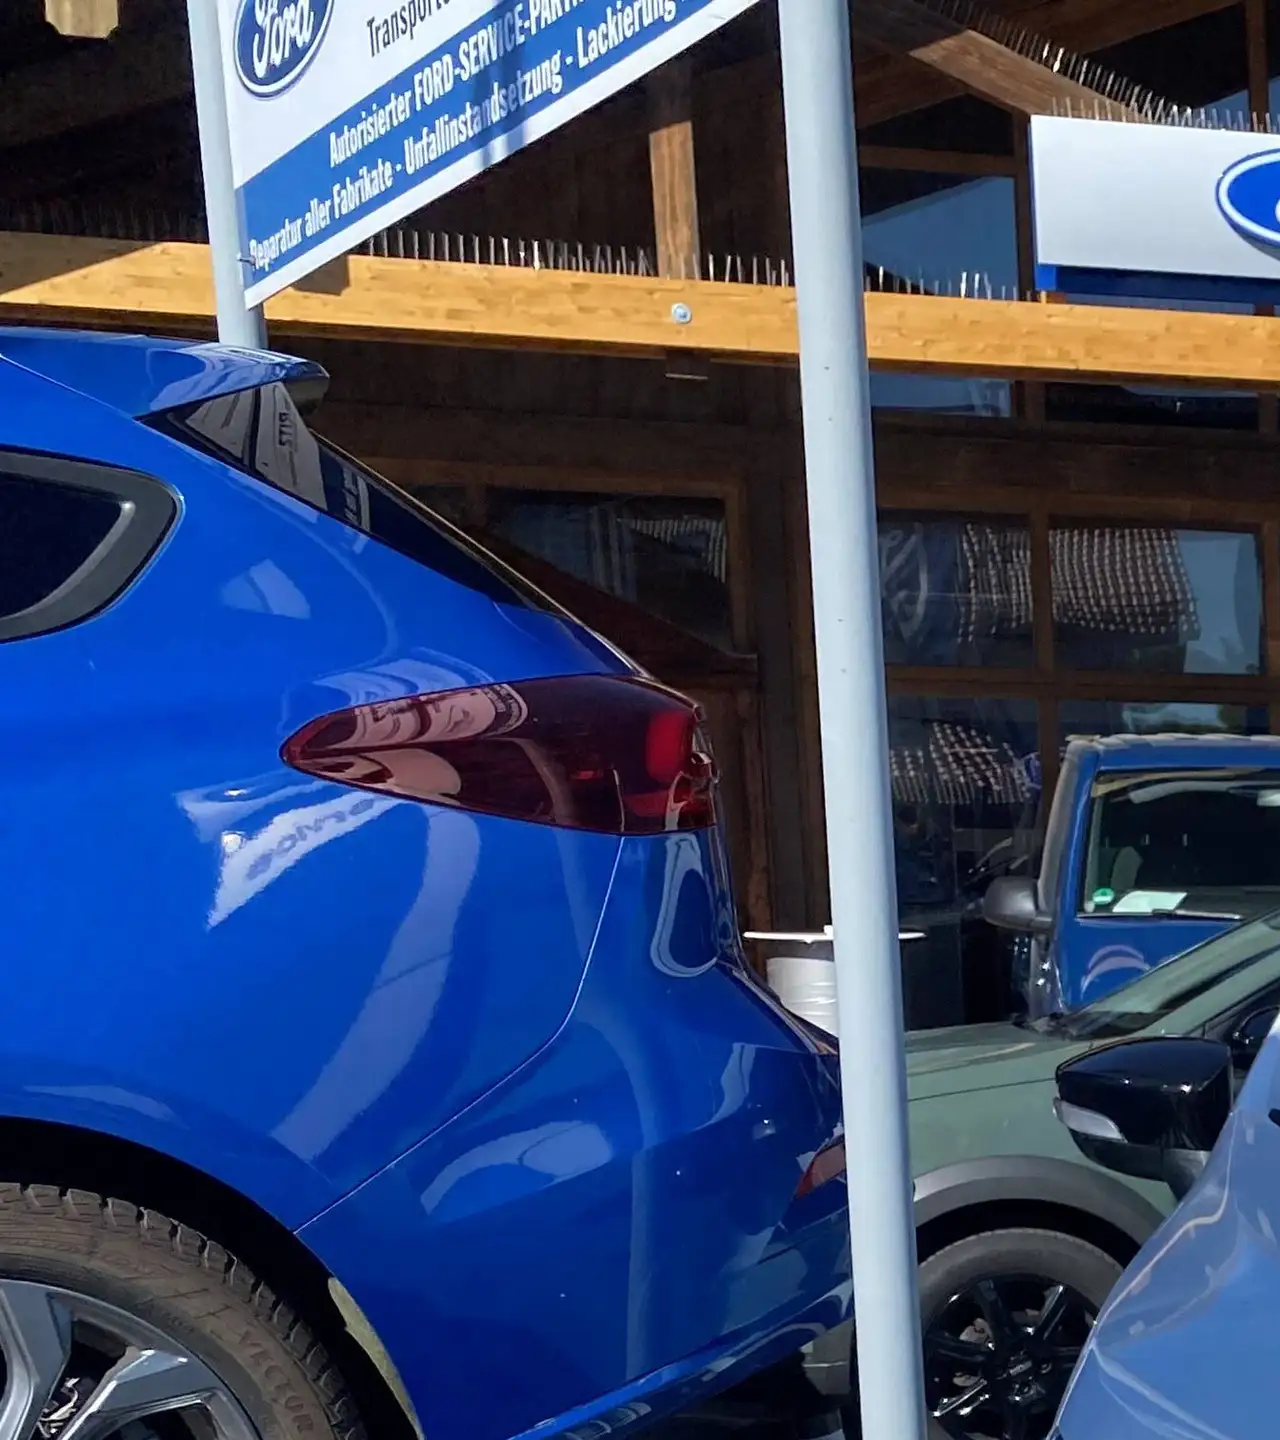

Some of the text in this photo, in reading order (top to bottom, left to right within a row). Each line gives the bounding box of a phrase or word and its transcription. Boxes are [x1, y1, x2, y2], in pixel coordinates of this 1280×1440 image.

[252, 0, 315, 79] Ford
[329, 0, 583, 169] Autorisierter FORD-SERVICE-PAR
[366, 0, 450, 58] Transpor
[249, 217, 303, 272] Reparatur
[304, 197, 332, 237] aller
[332, 158, 393, 219] Fabrikate
[403, 50, 563, 175] Unfallinstandsetzung
